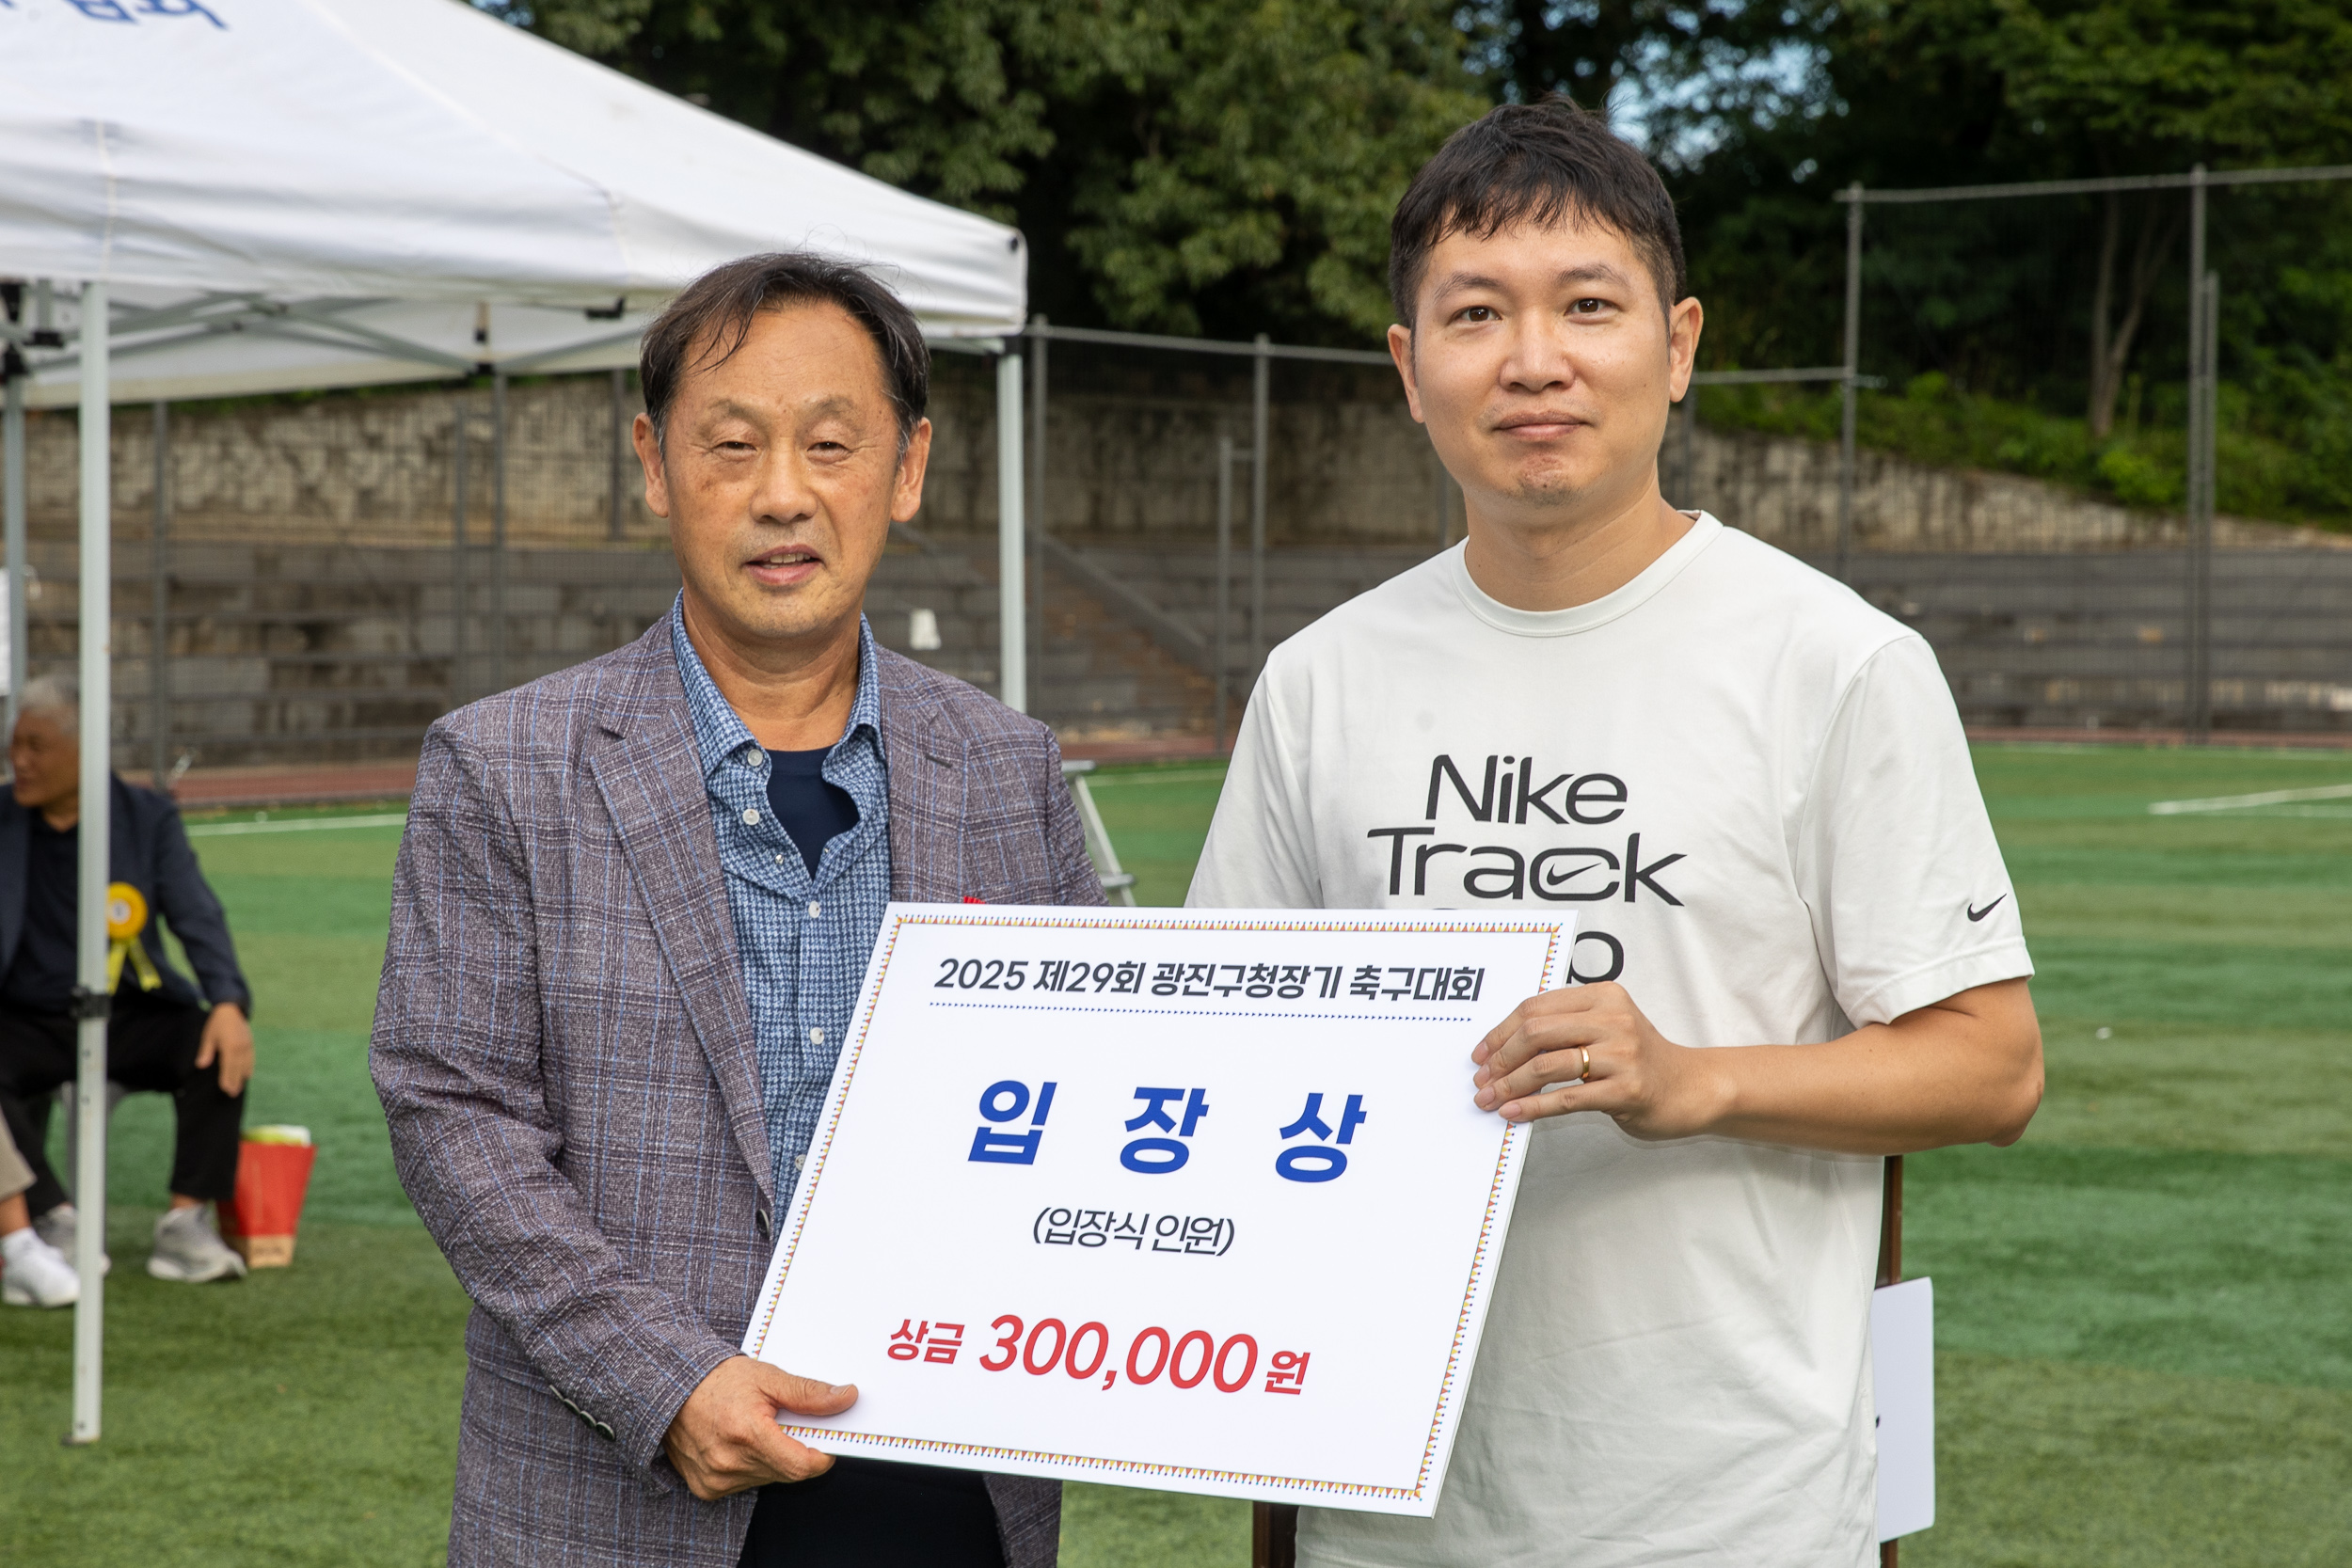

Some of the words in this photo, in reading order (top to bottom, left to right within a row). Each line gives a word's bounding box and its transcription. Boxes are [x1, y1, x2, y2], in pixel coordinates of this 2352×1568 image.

[1425, 754, 1628, 825] Nike
[1367, 827, 1689, 907] Track
[933, 958, 1029, 991] 2025
[1032, 960, 1147, 994] 제29회
[1151, 962, 1343, 1000] 광진구청장기
[1349, 964, 1486, 1002] 축구대회
[1033, 1207, 1151, 1250] (입장식
[1152, 1214, 1235, 1257] 인원)
[887, 1319, 965, 1365] 상금
